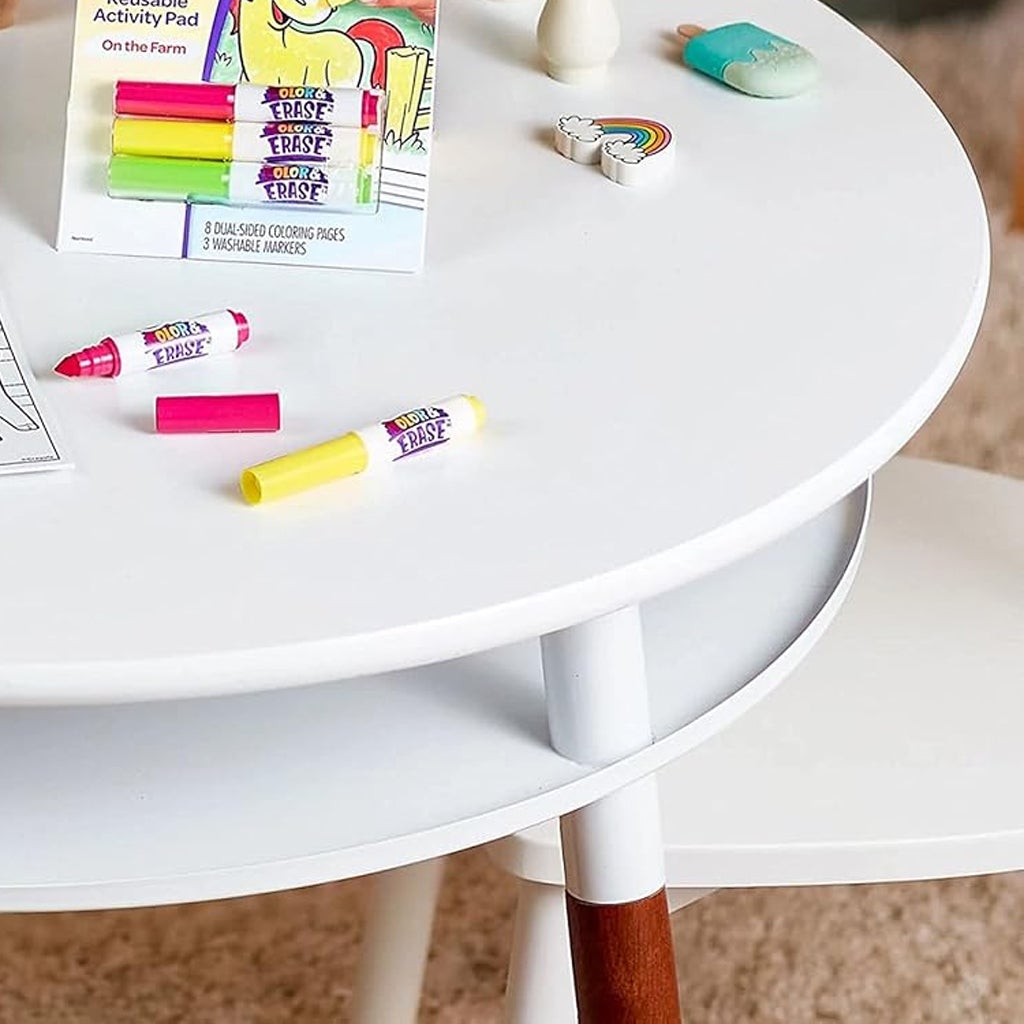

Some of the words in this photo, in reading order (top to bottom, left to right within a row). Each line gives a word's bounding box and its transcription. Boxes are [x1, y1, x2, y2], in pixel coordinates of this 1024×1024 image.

[93, 8, 162, 28] Activity
[165, 11, 199, 27] Pad
[102, 39, 122, 51] On
[125, 40, 148, 53] the
[150, 42, 187, 55] Farm
[269, 86, 315, 100] OLOR
[269, 101, 328, 121] ERASE
[267, 135, 326, 155] ERASE
[262, 166, 309, 180] OLOR
[263, 182, 322, 201] ERASE
[204, 221, 212, 235] 8
[214, 222, 266, 238] DUAL-SIDED
[268, 224, 315, 240] COLORING
[316, 227, 346, 242] PAGES
[202, 237, 210, 250] 3
[212, 238, 261, 253] WASHABLE
[263, 241, 307, 255] MARKERS
[152, 338, 205, 365] ERASE
[397, 419, 446, 453] ERASE
